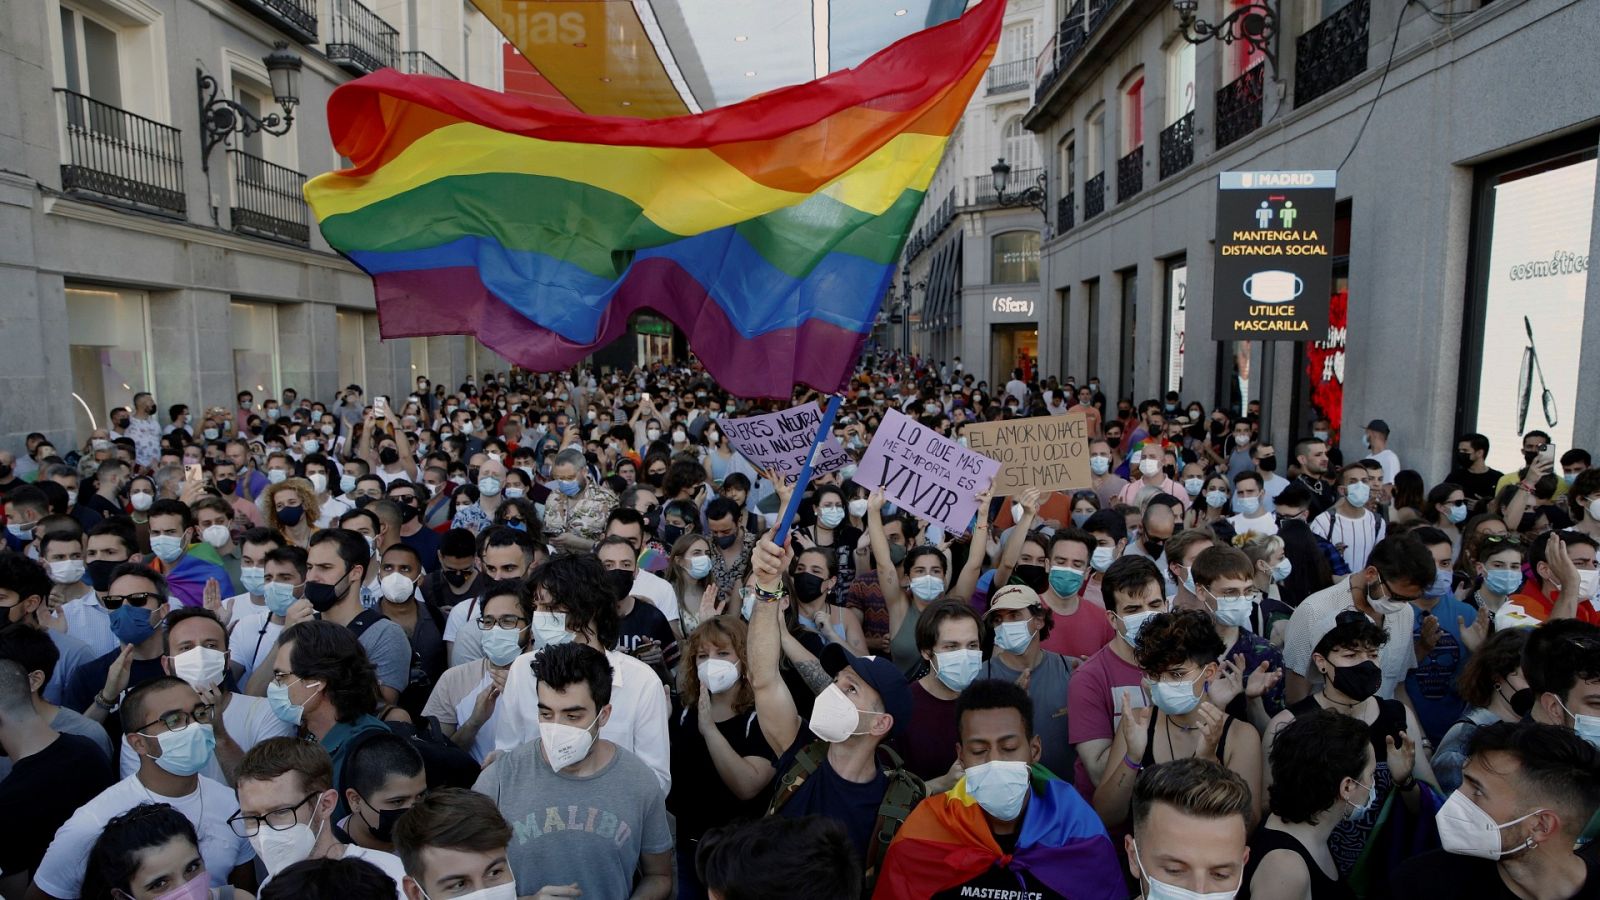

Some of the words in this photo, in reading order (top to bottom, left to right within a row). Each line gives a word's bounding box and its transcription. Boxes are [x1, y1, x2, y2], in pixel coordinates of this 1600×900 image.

[1260, 173, 1315, 186] MADRID
[1233, 230, 1300, 241] MANTENGA
[1302, 230, 1318, 241] LA
[1222, 245, 1283, 256] DISTANCIA
[1285, 245, 1328, 255] SOCIAL
[1249, 305, 1296, 316] UTILICE
[1234, 320, 1309, 331] MASCARILLA
[737, 420, 773, 440] ERES
[970, 431, 993, 448] EL
[996, 424, 1037, 446] AMOR
[1038, 423, 1057, 441] NO
[1058, 420, 1086, 440] HACE
[794, 455, 808, 466] E
[820, 447, 840, 459] EL
[897, 421, 922, 446] LO
[926, 437, 955, 463] QUE
[956, 452, 984, 475] MÁS
[1021, 445, 1040, 462] TU
[1043, 441, 1082, 461] ODIO
[882, 438, 900, 454] ME
[901, 447, 951, 481] IMPORTA
[957, 476, 977, 491] ES
[1005, 462, 1028, 487] SÍ
[1032, 463, 1071, 487] MATA
[877, 454, 959, 523] VIVIR
